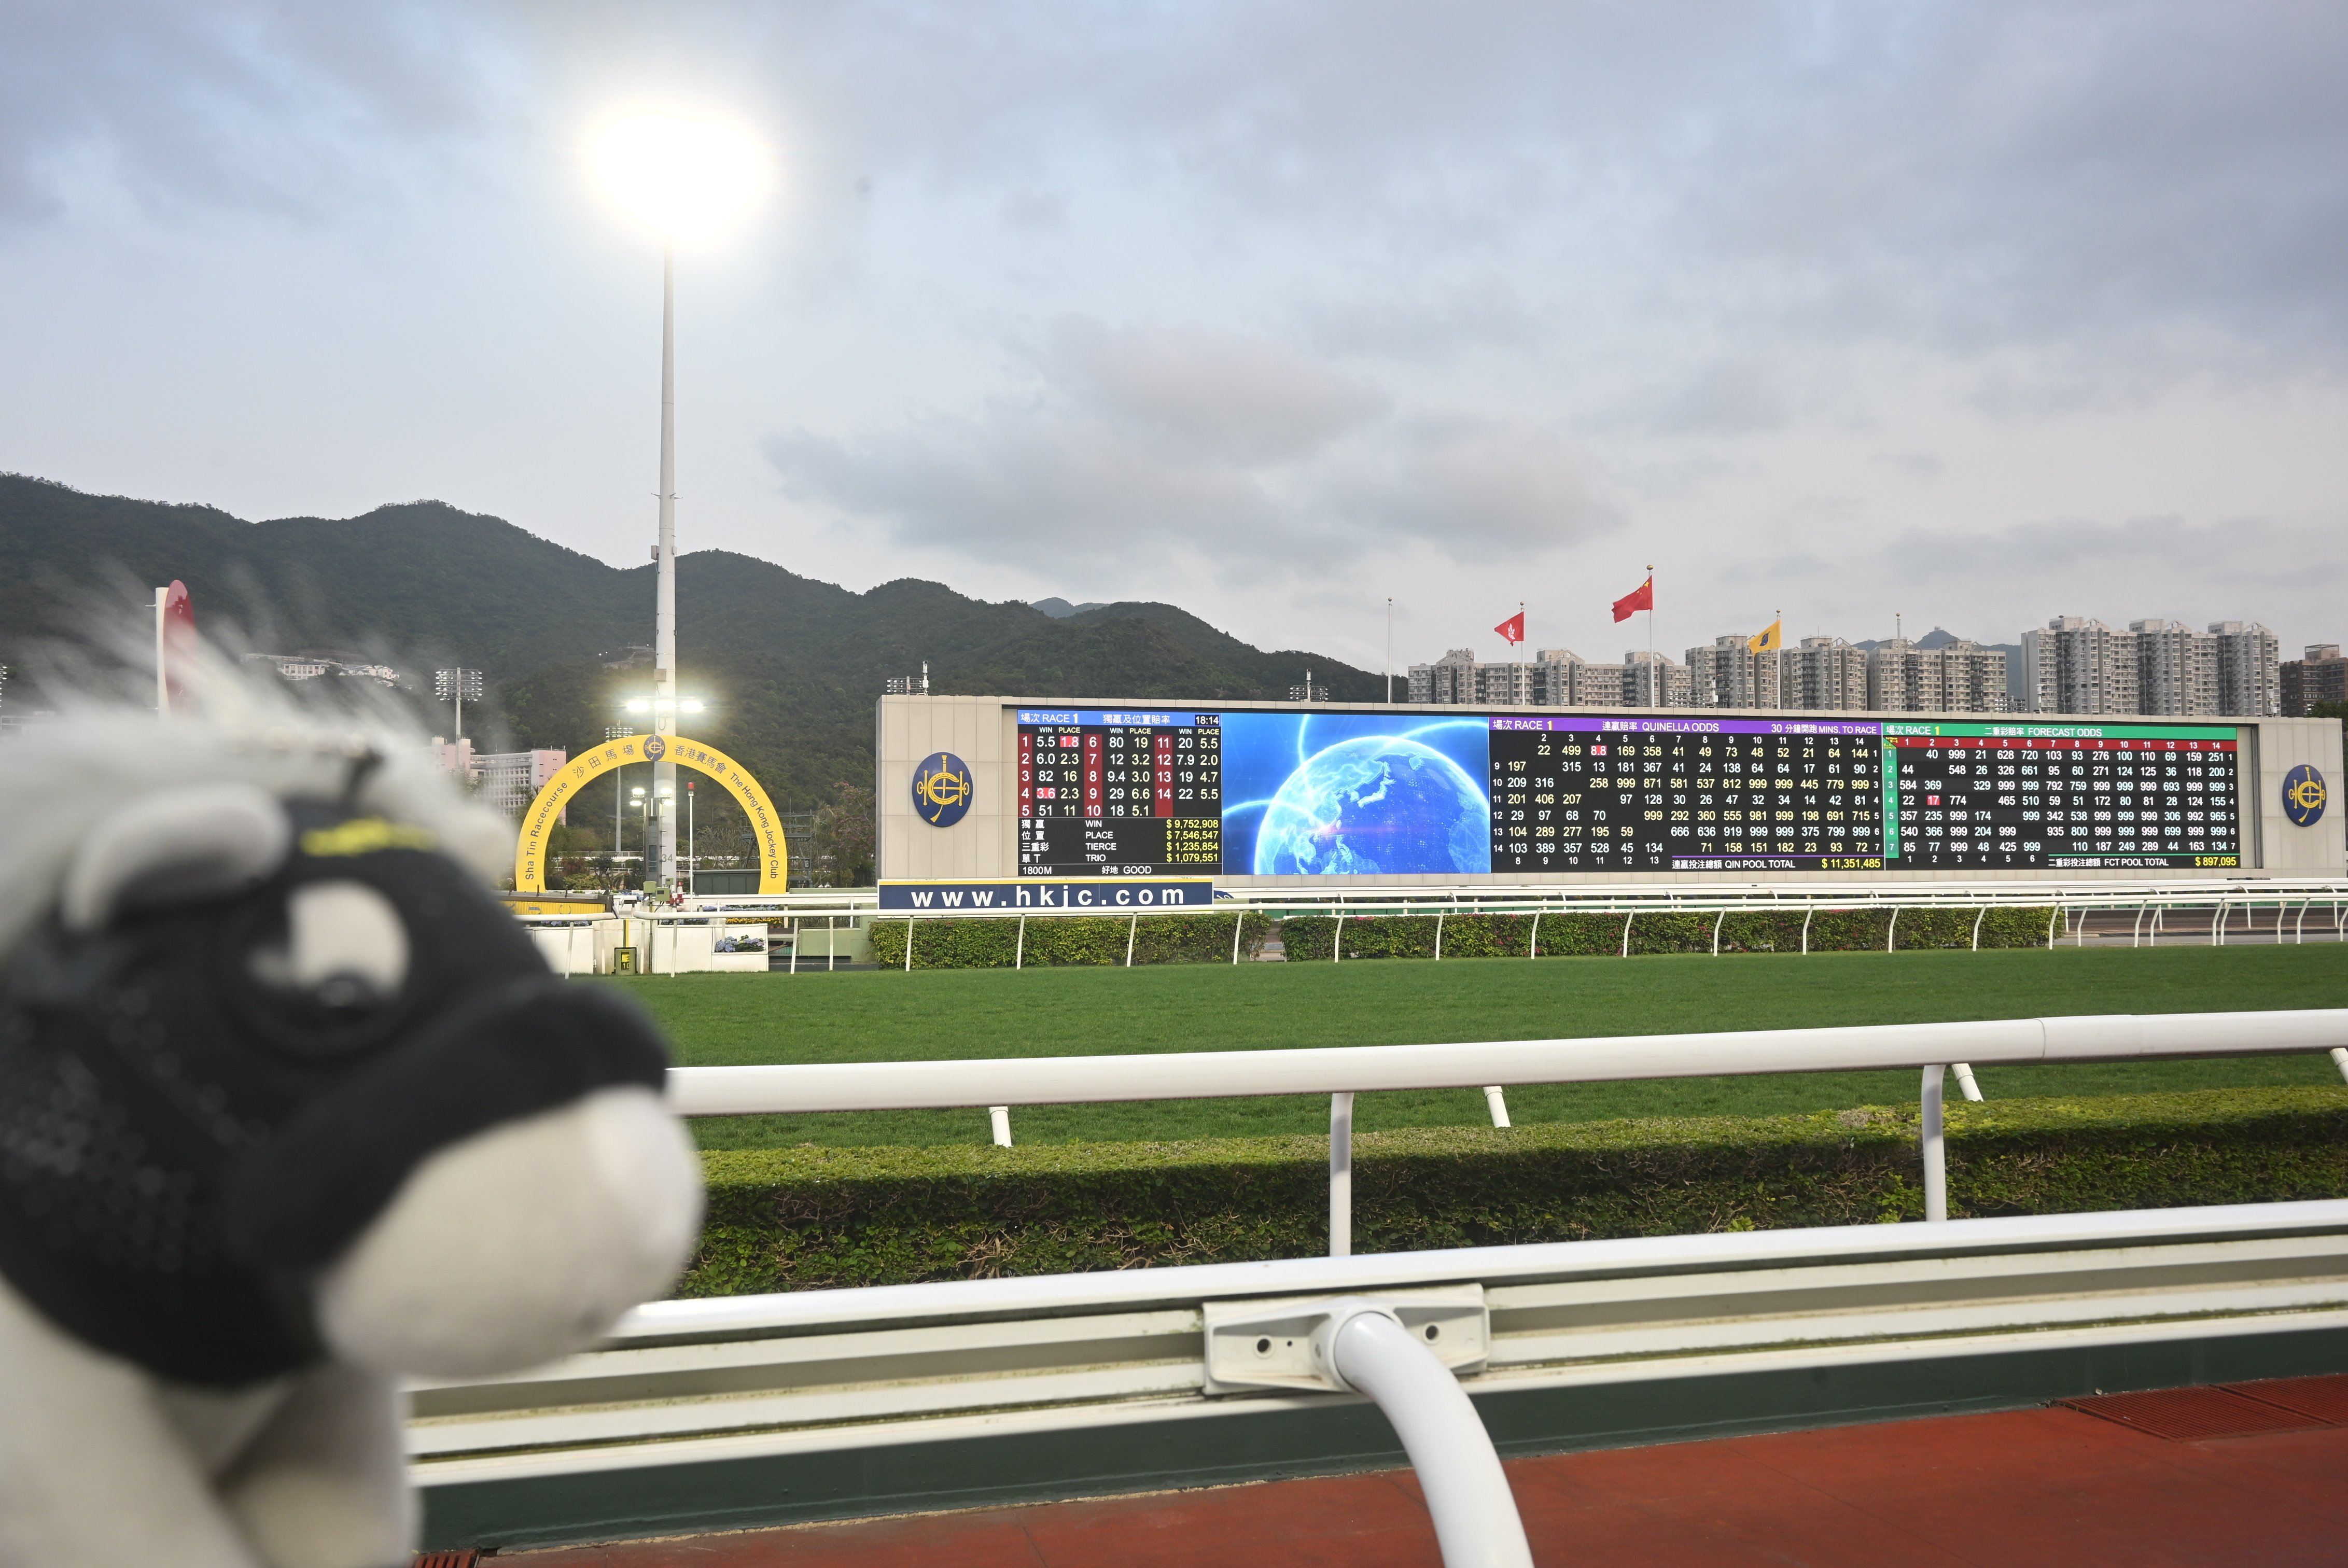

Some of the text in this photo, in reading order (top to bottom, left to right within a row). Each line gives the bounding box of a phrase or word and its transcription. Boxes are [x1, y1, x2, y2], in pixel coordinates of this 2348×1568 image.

[1021, 713, 1078, 724] 場次 RACE 1
[1493, 720, 1552, 730] 場次 RACE 1
[1642, 722, 1689, 731] QUINELLA
[1692, 723, 1719, 732] ODDS
[1771, 724, 1782, 733] 30
[1886, 725, 1939, 735] 場次 RACE 1
[1984, 727, 2024, 736] 二重彩賠率
[2029, 728, 2075, 736] FORECAST
[1023, 736, 1218, 748] 1 5.5 1.8 6 80 19 11 20 5.5
[1538, 745, 1550, 755] 22
[1562, 746, 1581, 755] 499
[1591, 746, 1606, 755] 8.8
[1617, 746, 1634, 755] 169
[1643, 746, 1661, 756] 358
[1673, 747, 1683, 756] 41
[1699, 747, 1711, 757] 49
[1726, 747, 1737, 757] 73
[1751, 748, 1763, 757] 48
[1778, 748, 1789, 757] 52
[1803, 748, 1813, 757] 21
[1828, 748, 1840, 758] 64
[1852, 749, 1868, 758] 144
[1926, 750, 1938, 759] 40
[1949, 750, 1965, 759] 999
[1976, 750, 1986, 759] 21
[1997, 750, 2014, 759] 628
[2021, 750, 2038, 760] 720
[2046, 751, 2062, 760] 103
[2072, 751, 2083, 760] 93
[2093, 751, 2109, 760] 276
[2117, 751, 2132, 760] 100
[2141, 752, 2155, 761] 110
[2165, 752, 2176, 761] 69
[2186, 752, 2202, 761] 159
[2209, 752, 2223, 761] 251
[572, 744, 634, 778] 沙田馬場
[675, 745, 726, 775] 香港賽馬會
[1022, 753, 1218, 765] 2 6.0 2.3 7 12 3.2 12 7.9 2.0
[1022, 771, 1218, 782] 3 82 16 8 9.4 3.0 13 19 4.7
[1022, 788, 1218, 799] 4 3.6 2.3 9 29 6.6 14 22 5.5
[530, 782, 568, 837] Racecourse
[1022, 805, 1148, 816] 5 51 11 10 18 5.1
[730, 772, 744, 788] The
[741, 786, 758, 808] Hong
[755, 805, 769, 828] Kong
[765, 829, 776, 859] Jockey
[1175, 820, 1218, 829] 9,752,908
[1175, 831, 1218, 841] 7,546,547
[527, 842, 536, 856] Tin
[1022, 842, 1049, 851] 三重彩
[1176, 842, 1218, 851] 1,235,854
[662, 853, 673, 863] 34
[1176, 853, 1217, 863] 1,079,551
[2203, 857, 2236, 866] 897,095
[1725, 860, 1740, 869] QIN
[1831, 859, 1880, 869] 11,351,485
[1102, 866, 1118, 874] 好地
[911, 885, 1183, 907] www.hkjc.com
